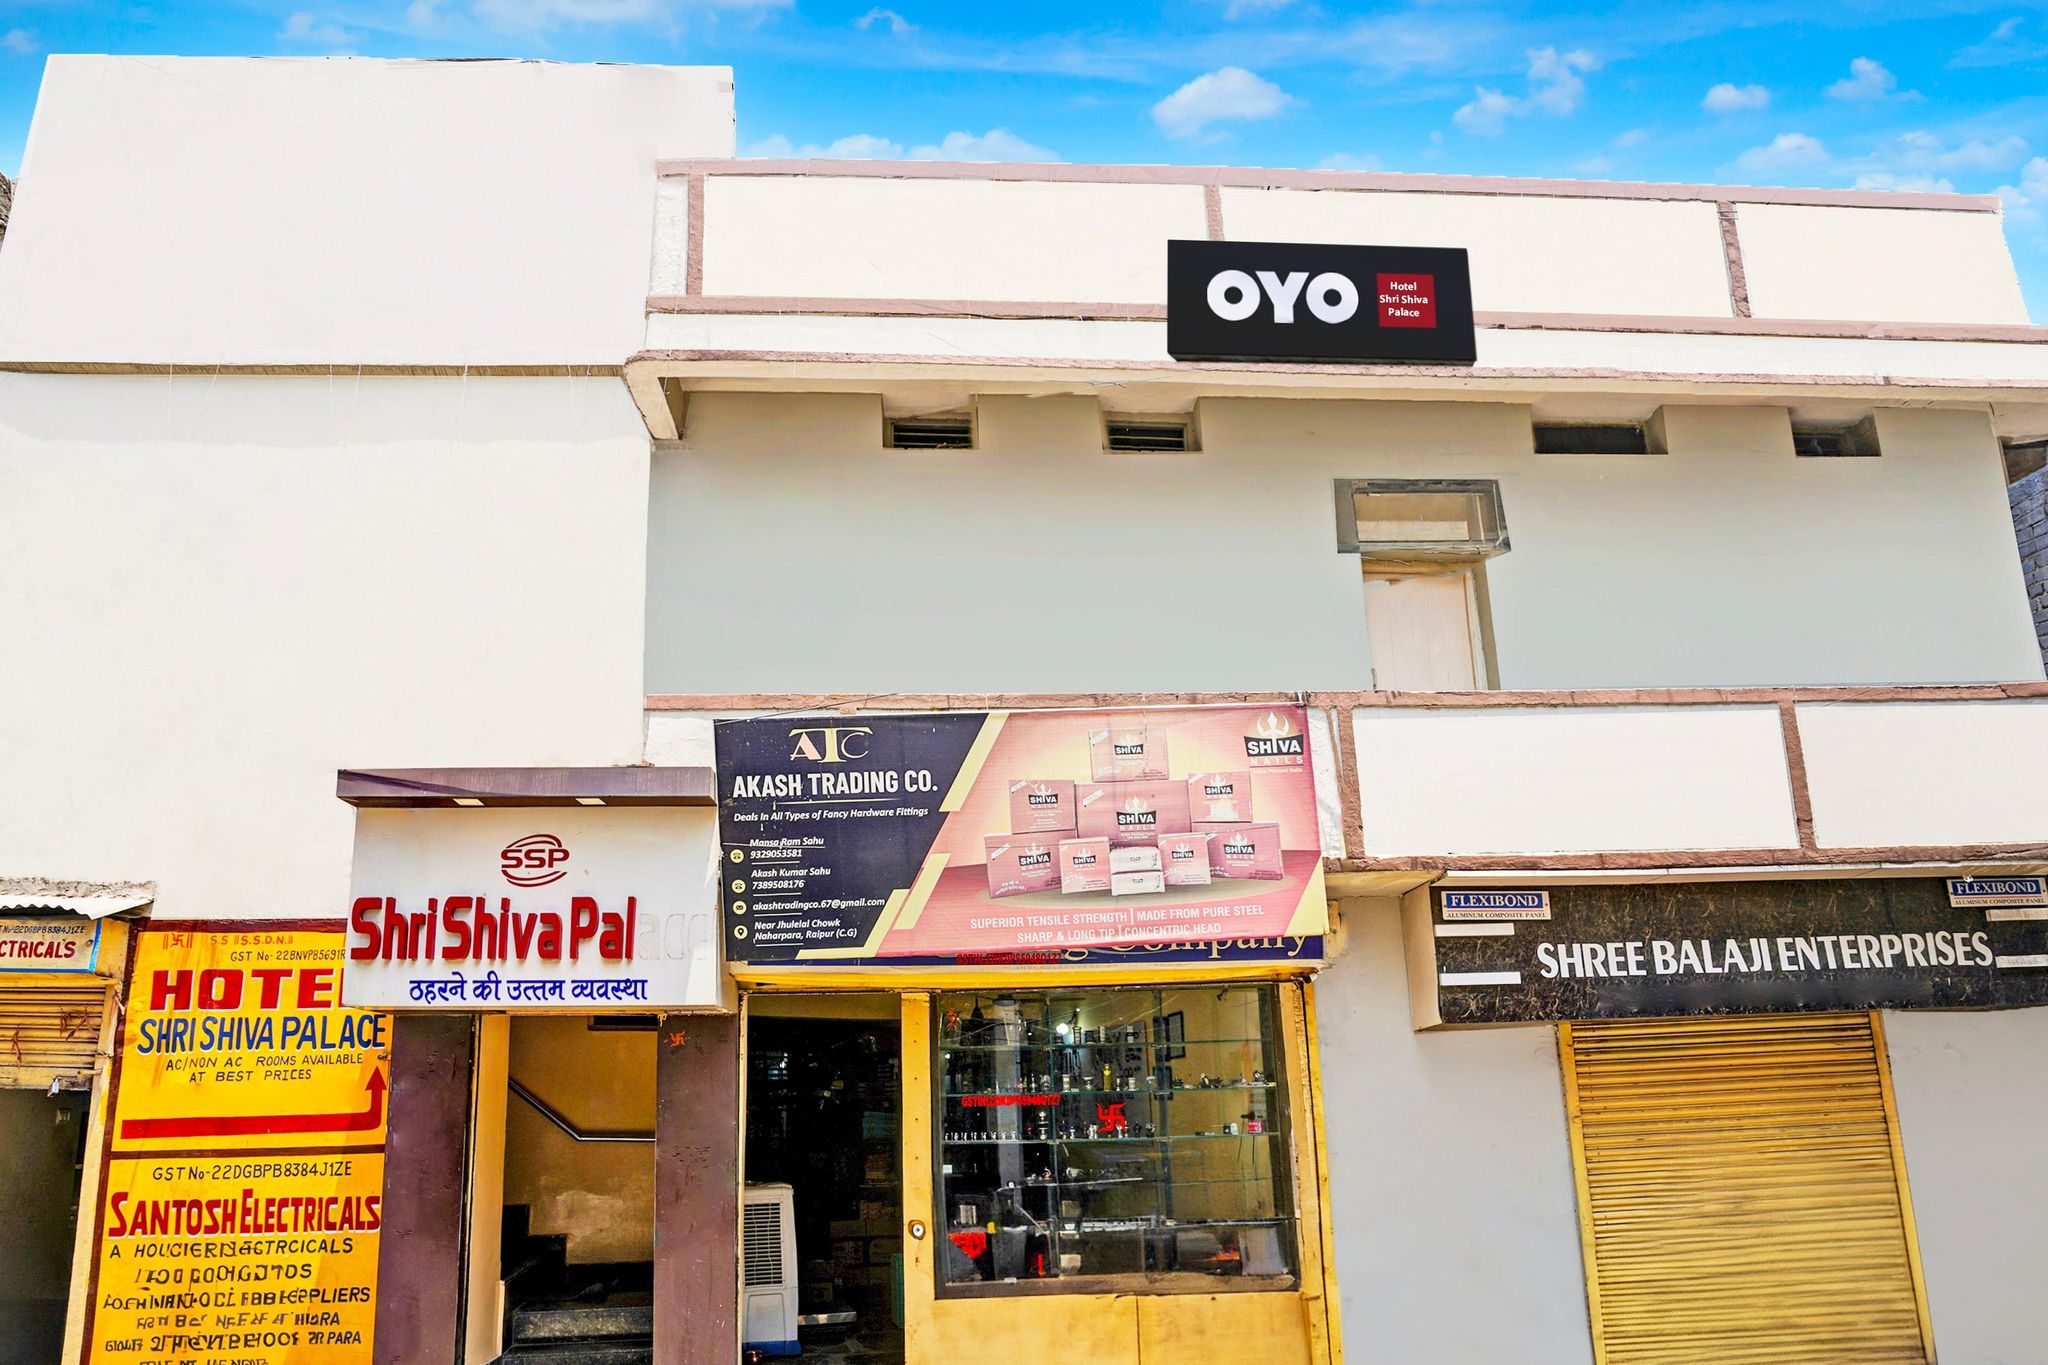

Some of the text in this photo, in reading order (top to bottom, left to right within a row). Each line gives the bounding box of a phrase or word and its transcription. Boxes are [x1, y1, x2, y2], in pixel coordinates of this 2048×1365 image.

[1390, 281, 1417, 291] Hotel
[1207, 269, 1359, 324] OYO
[1379, 294, 1429, 304] Shri Shiva
[1388, 307, 1420, 317] Palace
[788, 727, 874, 763] ATC
[1115, 746, 1143, 754] SHIVA
[1247, 738, 1302, 755] SHIVA
[732, 769, 939, 798] AKASH TRADING CO.
[1205, 786, 1232, 794] SHIVA
[1029, 795, 1057, 804] SHIVA
[733, 806, 929, 823] Deals In All Types of Fancy Hardware Fittings
[1118, 813, 1155, 824] SHIVA
[750, 836, 824, 847] Mansa Ram Sahu
[750, 849, 802, 859] 9329053581
[1172, 851, 1193, 859] SHIVA
[1225, 846, 1254, 854] SHIVA
[500, 848, 571, 869] SSP
[1020, 854, 1050, 865] SHIVA
[1073, 857, 1096, 865] SHIVA
[751, 866, 831, 878] Akash Kumar Sahu
[752, 880, 804, 890] 7389508176
[1956, 881, 2037, 894] FLEXIBOND
[1450, 894, 1539, 907] FLEXIBOND
[970, 904, 1265, 929] SUPERIOR TENSILE STRENGTH MADE FROM PURE STEEL
[350, 896, 439, 960] Shri
[441, 896, 564, 960] Shiva
[754, 921, 776, 930] Near
[811, 918, 841, 928] Chowk
[805, 929, 834, 941] Raipur
[836, 928, 857, 939] (C.G)
[1017, 922, 1221, 943] SHARP & LONG TIP CONCENTRIC HEAD
[230, 951, 253, 961] GST
[1536, 930, 1994, 979] SHREE BALAJI ENTERPRISES
[149, 967, 344, 1011] HOTE
[409, 970, 649, 1004] ठहरने की उत्तम व्यवस्था
[137, 1012, 387, 1055] SHRI SHIVA PALACE
[165, 1053, 363, 1071] AC/NON AC ROOMS AVAILABLE
[189, 1069, 312, 1083] AT BEST PRICES
[152, 1165, 185, 1181] GST
[107, 1187, 382, 1239] SANTOSH ELECTRICALS
